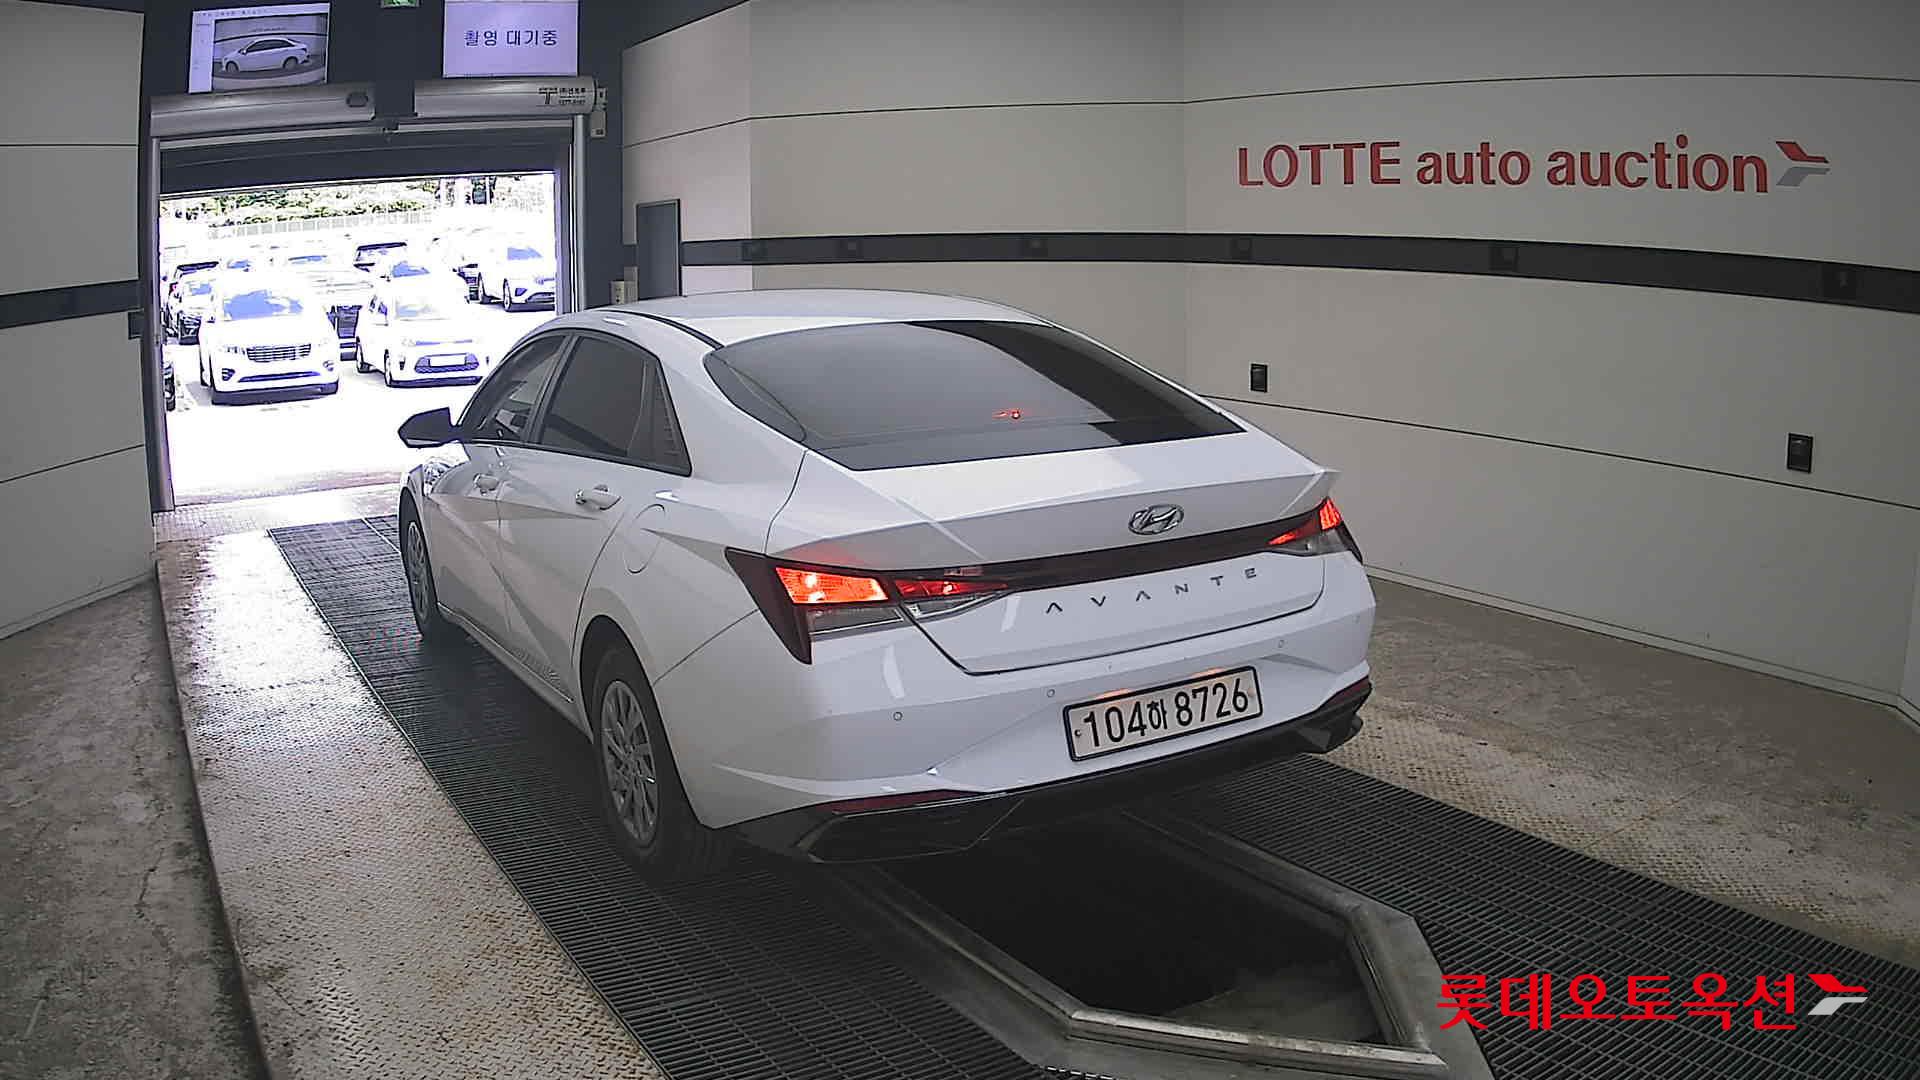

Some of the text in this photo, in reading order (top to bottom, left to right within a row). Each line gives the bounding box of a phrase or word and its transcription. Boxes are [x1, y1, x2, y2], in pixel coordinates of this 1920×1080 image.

[506, 30, 558, 46] 대기중
[1239, 134, 1769, 194] LOTTE auto auction
[1045, 567, 1258, 614] AVANTE
[1083, 677, 1249, 747] 104하 8726
